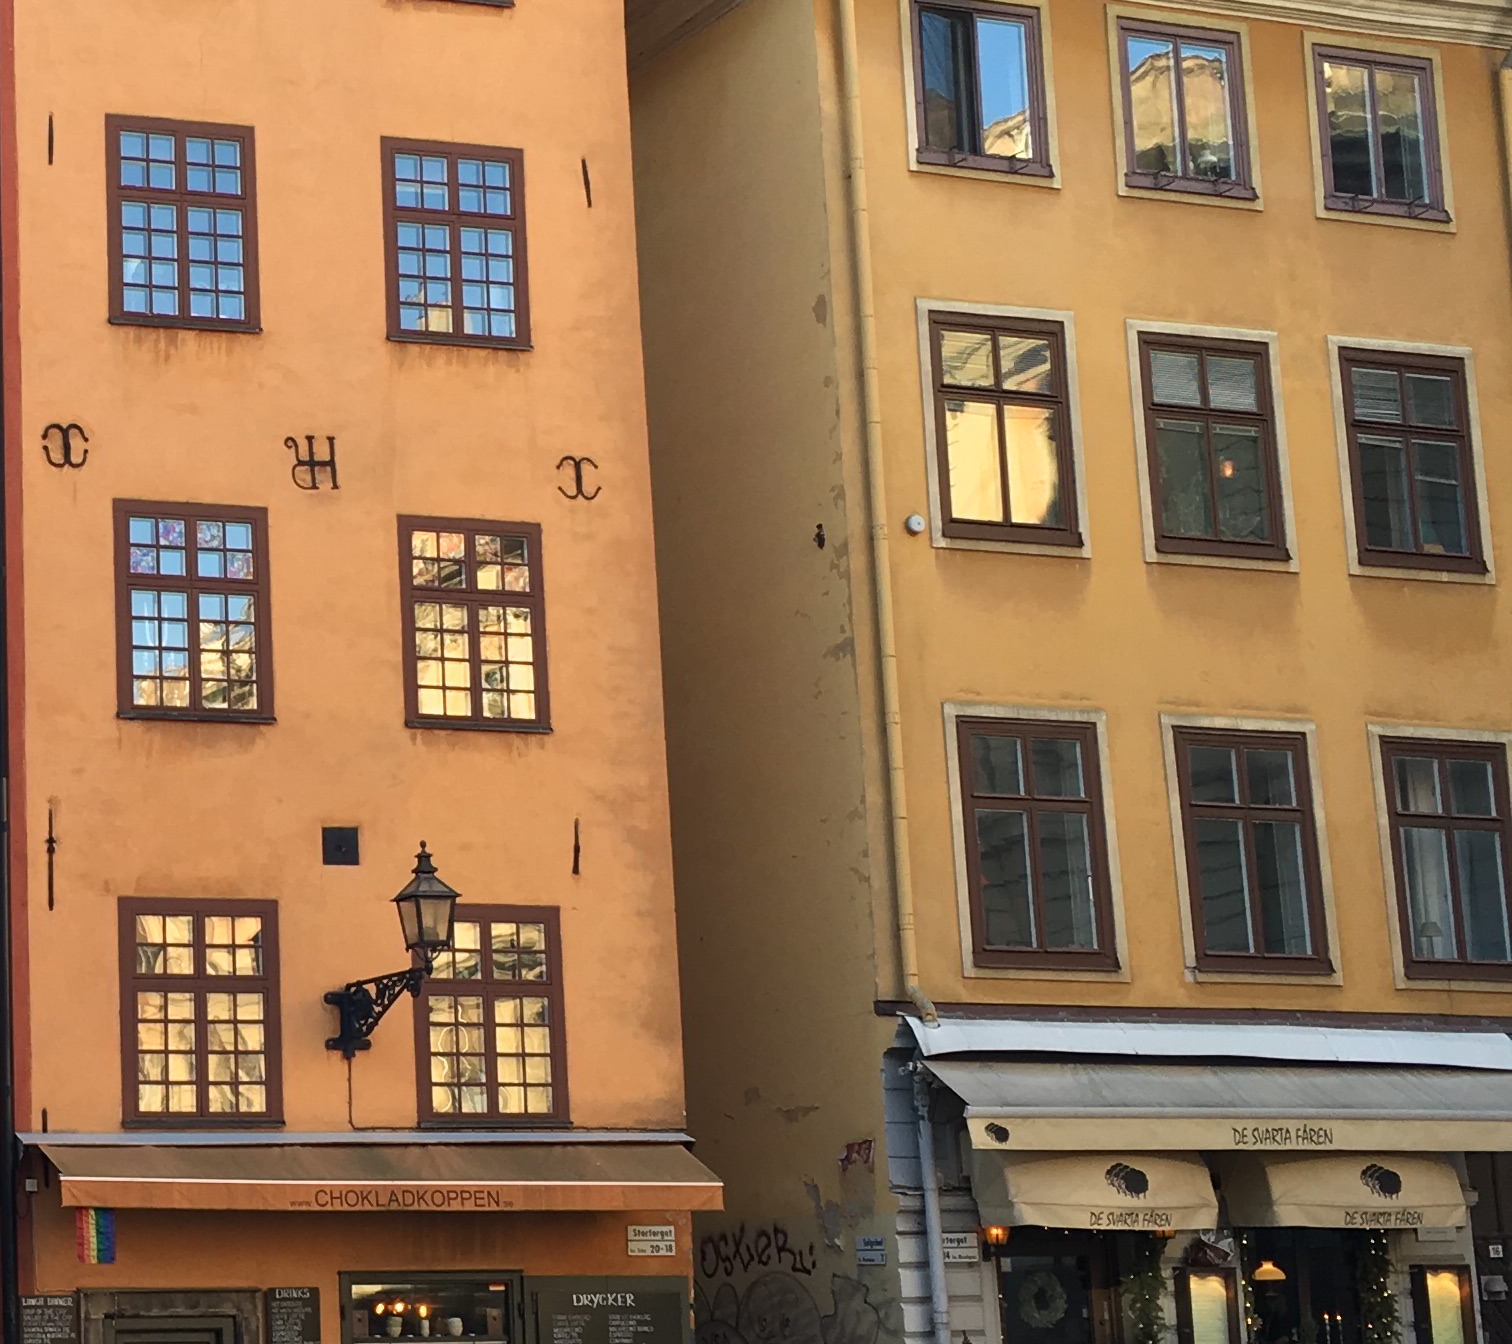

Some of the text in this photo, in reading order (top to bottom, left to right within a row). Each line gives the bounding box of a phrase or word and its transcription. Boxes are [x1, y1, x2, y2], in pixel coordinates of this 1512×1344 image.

[1232, 1123, 1333, 1146] DE SVARTA FÅREN
[1090, 1210, 1172, 1227] DE SVARTA FÅREN
[1345, 1208, 1423, 1226] DE SVARTA FÅREN
[633, 1228, 672, 1240] Stortorget
[650, 1244, 673, 1253] 20-18
[275, 1288, 310, 1298] DRINKS
[572, 1293, 636, 1308] DRYCKER
